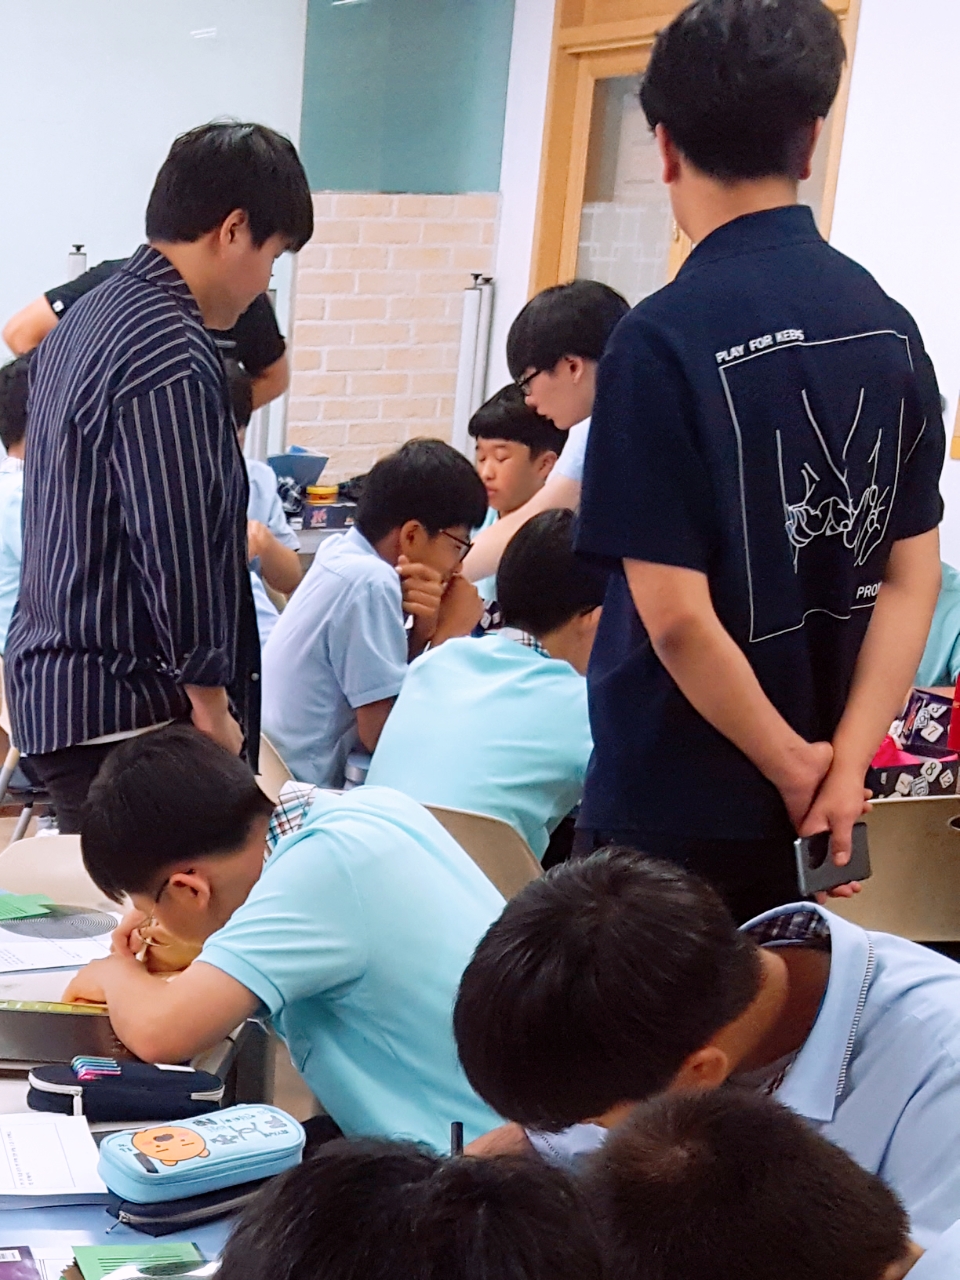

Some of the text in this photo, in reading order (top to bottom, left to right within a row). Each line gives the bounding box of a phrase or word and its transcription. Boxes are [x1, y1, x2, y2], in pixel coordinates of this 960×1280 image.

[715, 344, 745, 363] PLAY
[749, 335, 773, 351] FOR
[927, 725, 939, 736] 7
[925, 762, 937, 776] 8
